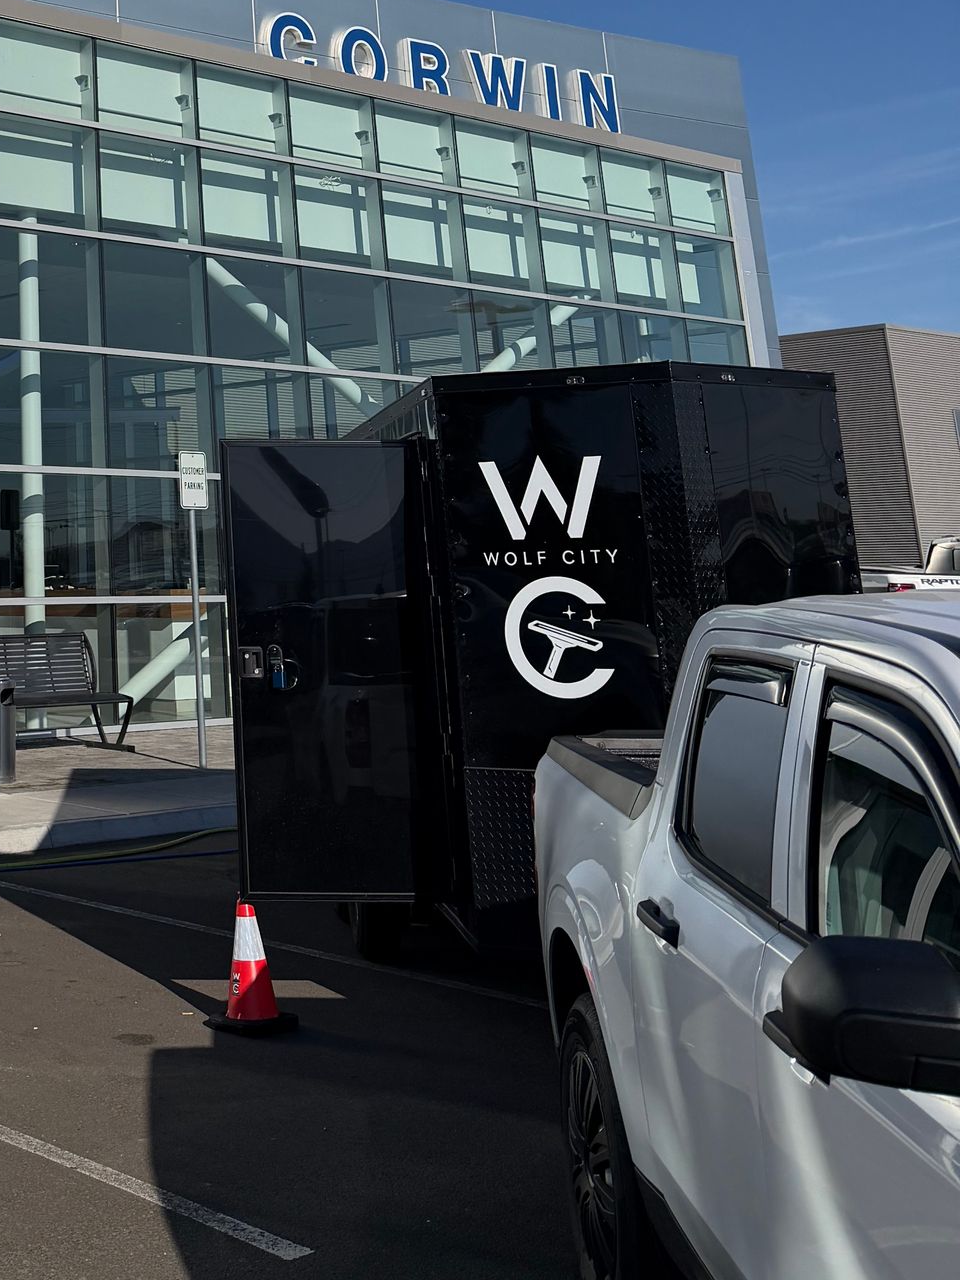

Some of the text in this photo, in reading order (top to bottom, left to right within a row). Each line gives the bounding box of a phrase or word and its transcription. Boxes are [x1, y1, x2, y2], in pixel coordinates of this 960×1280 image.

[262, 12, 622, 134] CORWIN
[182, 466, 204, 476] CUSTOMER
[184, 481, 204, 490] PARKING
[478, 454, 602, 541] W
[483, 548, 620, 566] WOLF CITY
